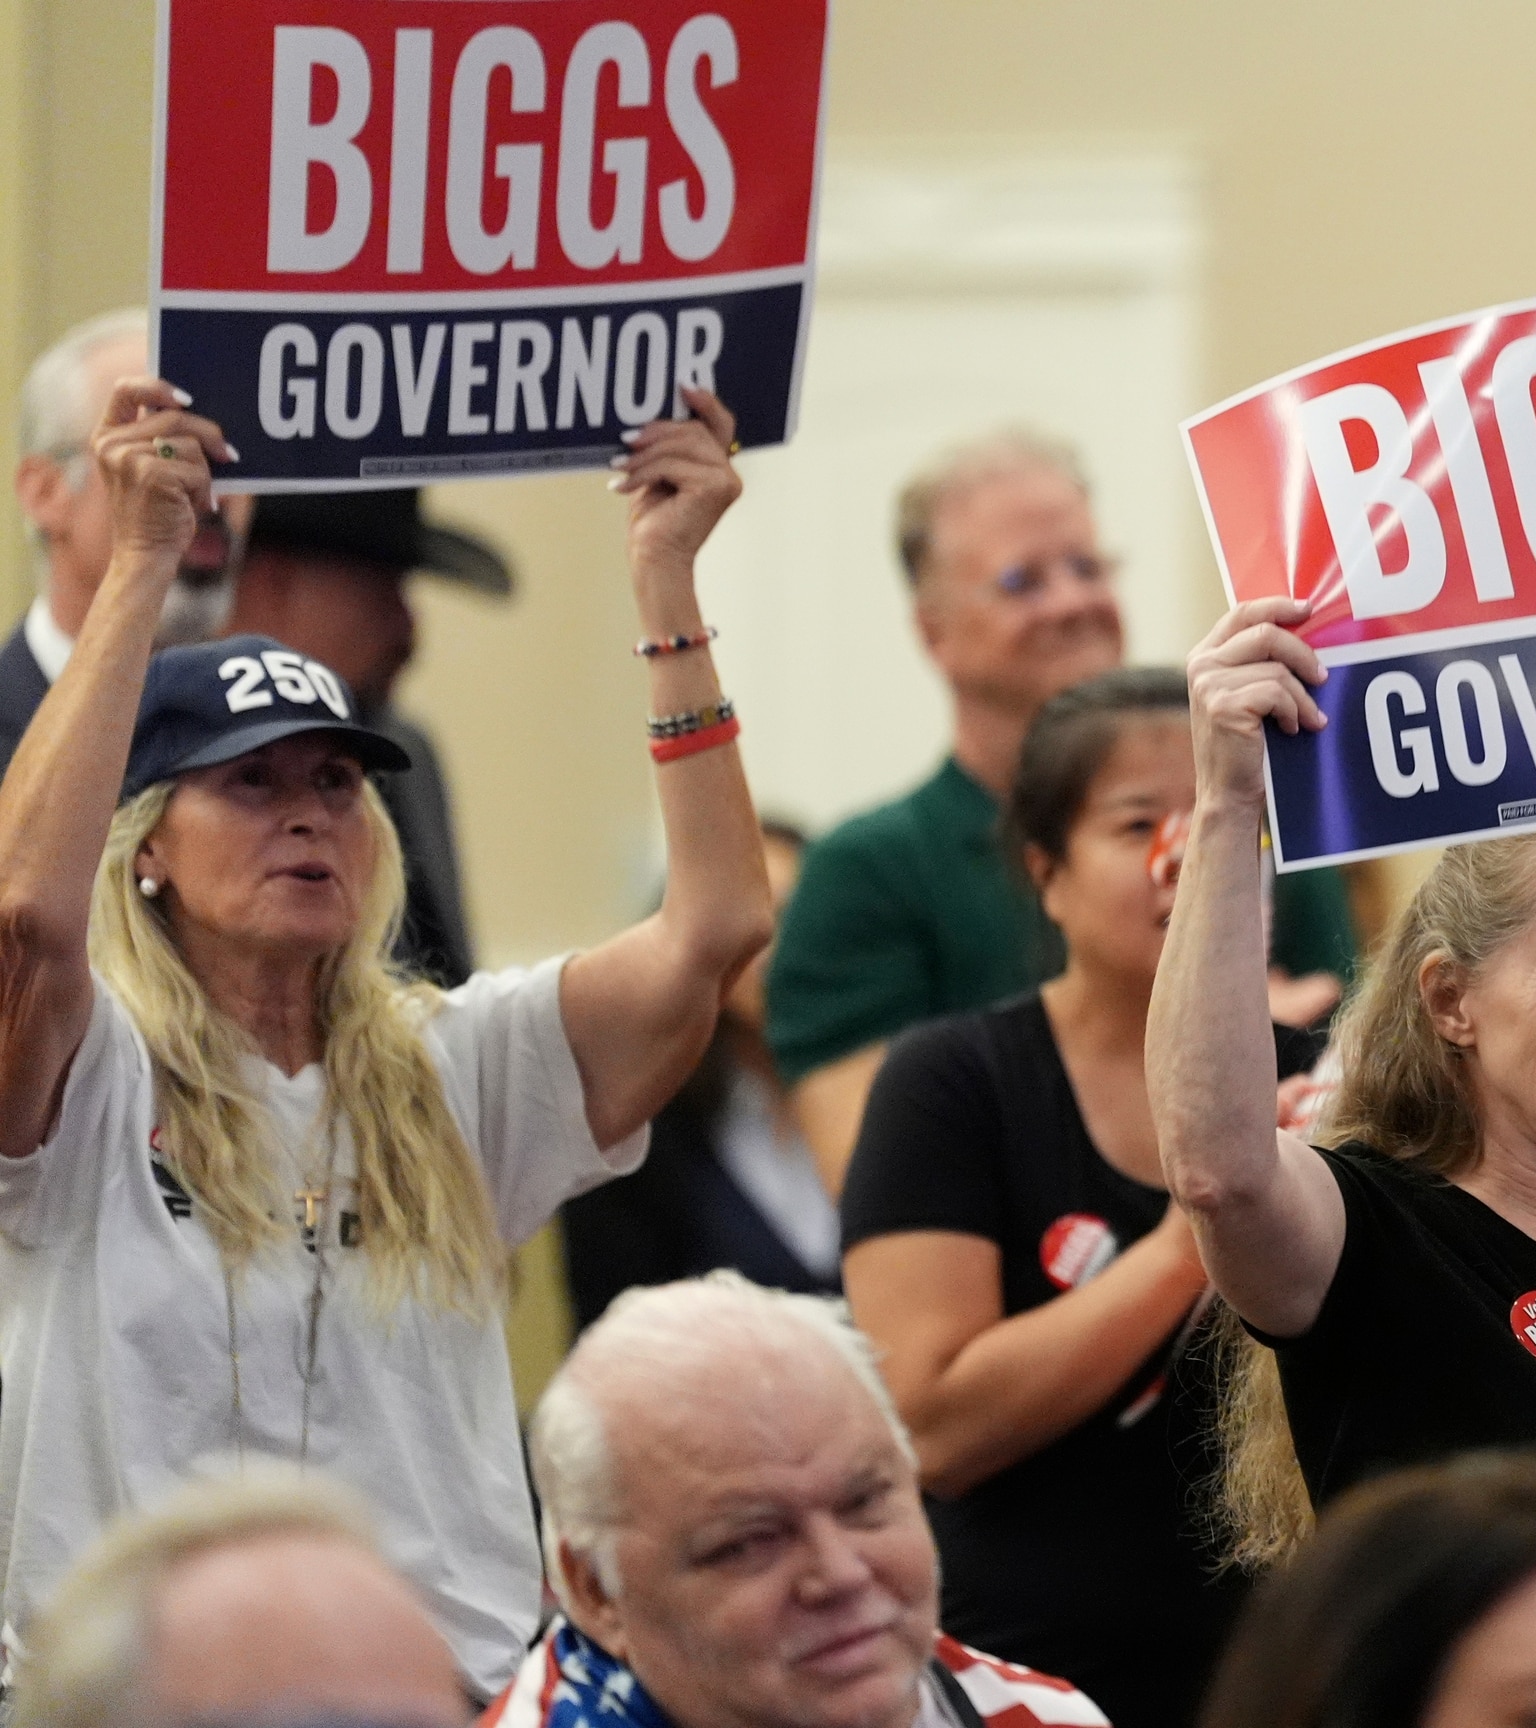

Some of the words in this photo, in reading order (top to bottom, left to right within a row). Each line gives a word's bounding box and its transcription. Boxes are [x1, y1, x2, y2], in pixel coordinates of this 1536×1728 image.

[266, 13, 739, 275] BIGGS
[257, 308, 724, 439] GOVERNOR
[218, 650, 349, 720] 250
